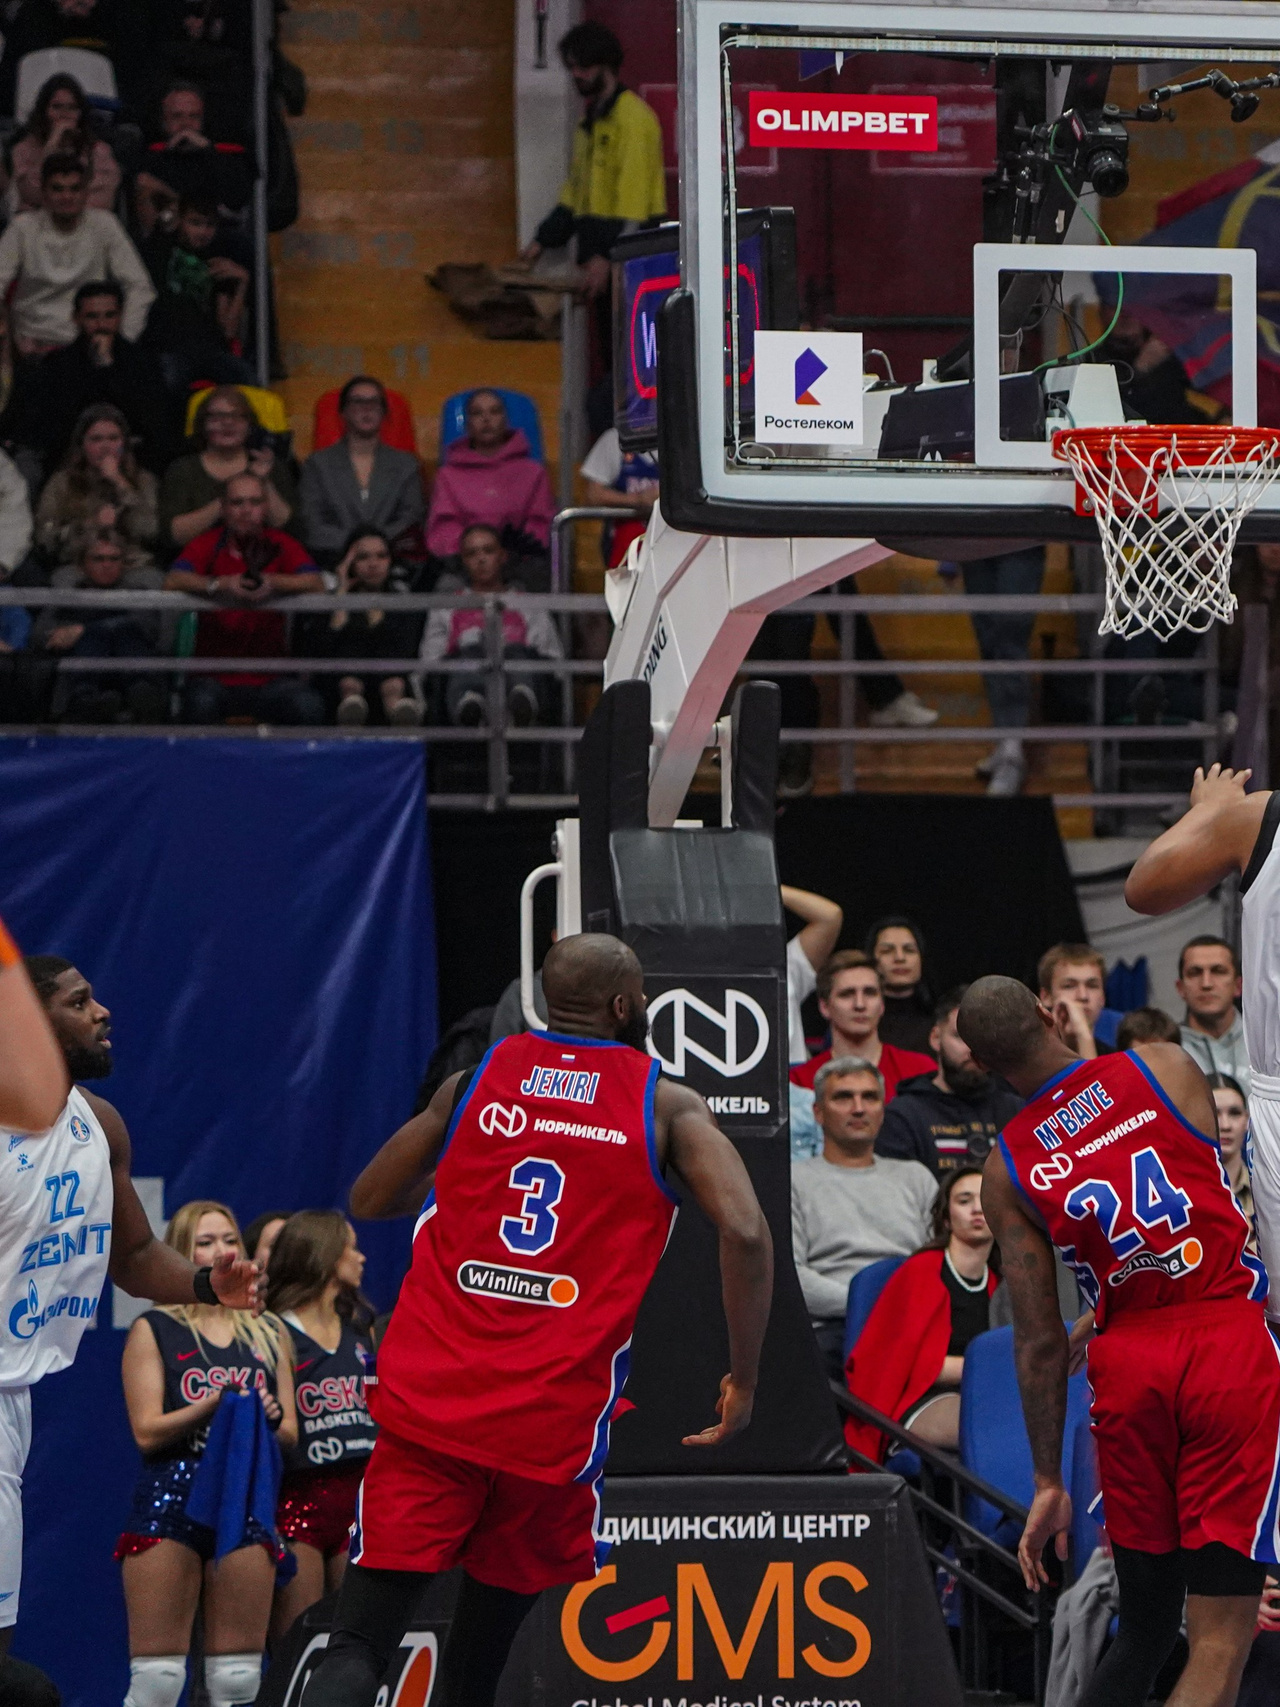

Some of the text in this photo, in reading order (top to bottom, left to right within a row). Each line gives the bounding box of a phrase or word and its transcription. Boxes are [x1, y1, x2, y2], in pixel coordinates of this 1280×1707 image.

[756, 108, 930, 134] OLIMPBET
[764, 415, 854, 430] Ростелеком
[520, 1065, 600, 1105] JEKIRI
[533, 1118, 628, 1145] НОРНИКЕЛЬ
[1033, 1080, 1115, 1151] M'BAYE
[1075, 1109, 1158, 1158] НОРНИКЕЛЬ
[45, 1170, 85, 1224] 22
[498, 1156, 566, 1257] 3
[1064, 1146, 1194, 1261] 24
[468, 1267, 544, 1298] Winline
[783, 1514, 871, 1543] ЦЕНТР
[560, 1561, 872, 1682] GMS
